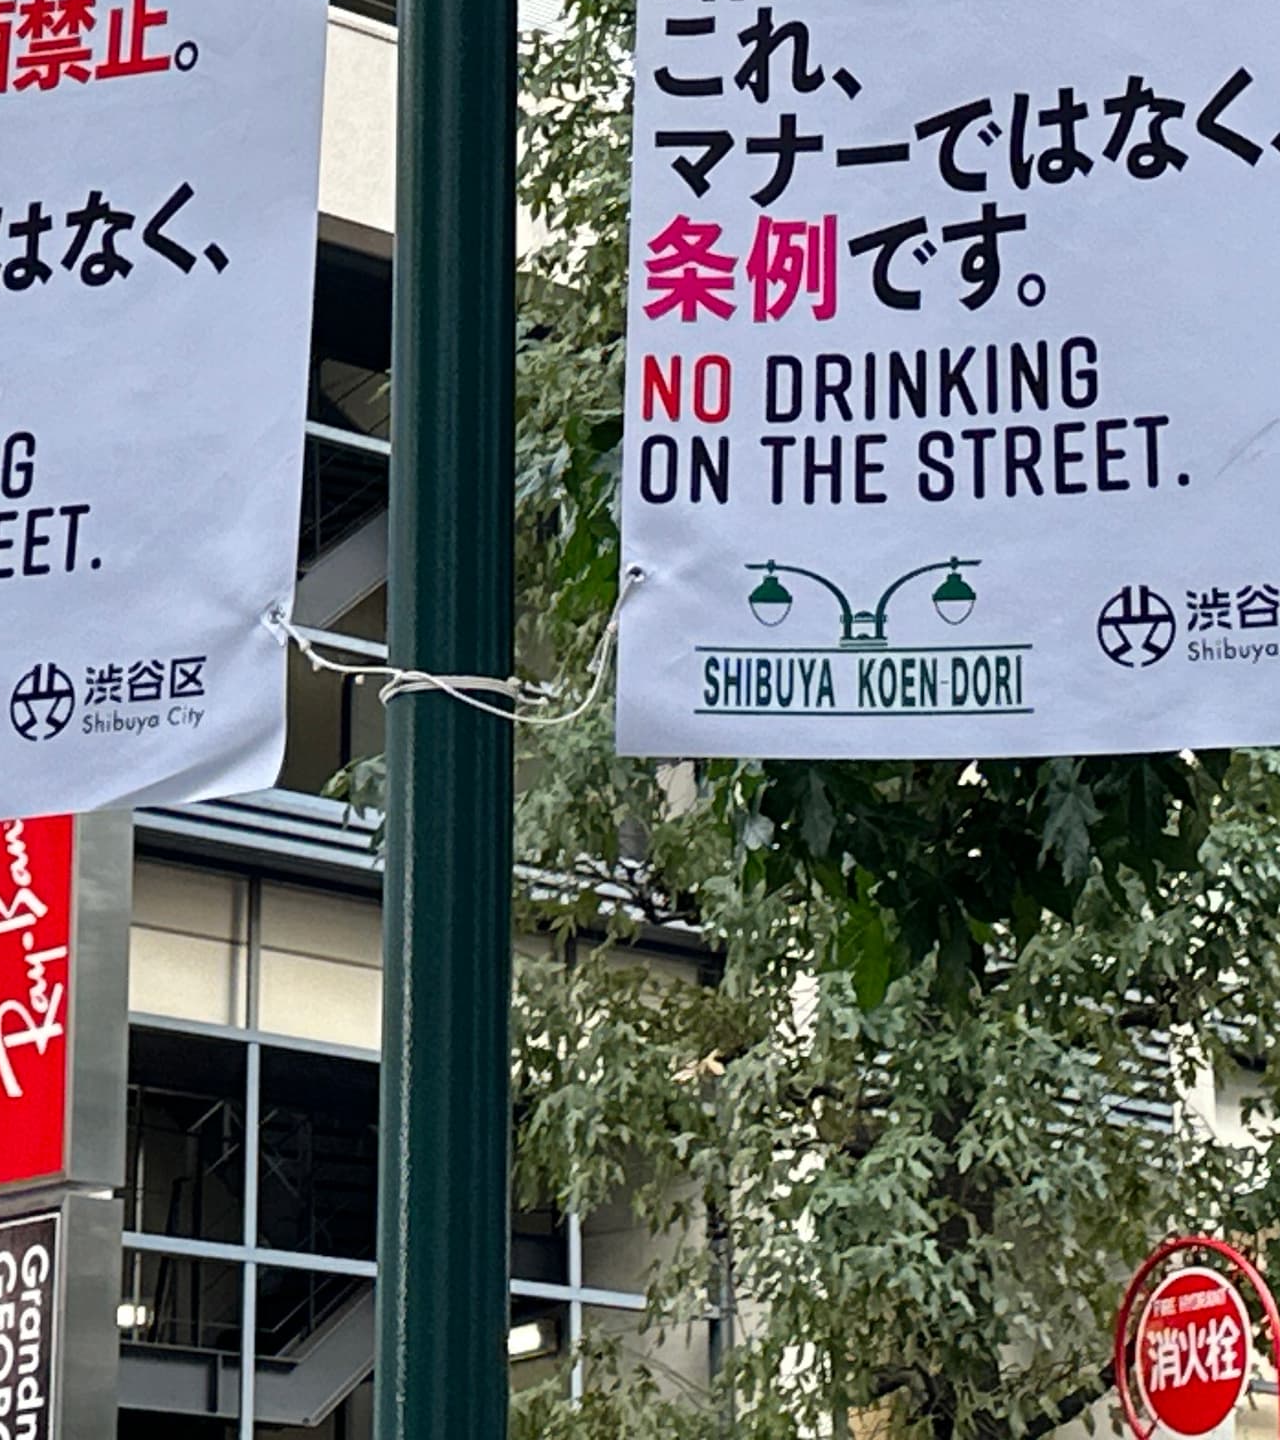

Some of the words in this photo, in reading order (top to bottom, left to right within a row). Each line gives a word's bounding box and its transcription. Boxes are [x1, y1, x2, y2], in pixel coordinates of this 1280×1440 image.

[653, 7, 863, 104] これ、
[643, 201, 1046, 323] 条例です。
[642, 354, 732, 423] NO
[765, 336, 1098, 423] DRINKING
[639, 433, 730, 505] ON
[761, 433, 888, 505] THE
[919, 415, 1191, 502] STREET.
[85, 656, 208, 707] 渋谷区
[703, 656, 836, 708] SHIBUYA
[1187, 637, 1280, 664] Shibuya
[82, 712, 160, 736] Shibuya
[167, 705, 206, 731] City
[1146, 1315, 1242, 1392] 消火栓
